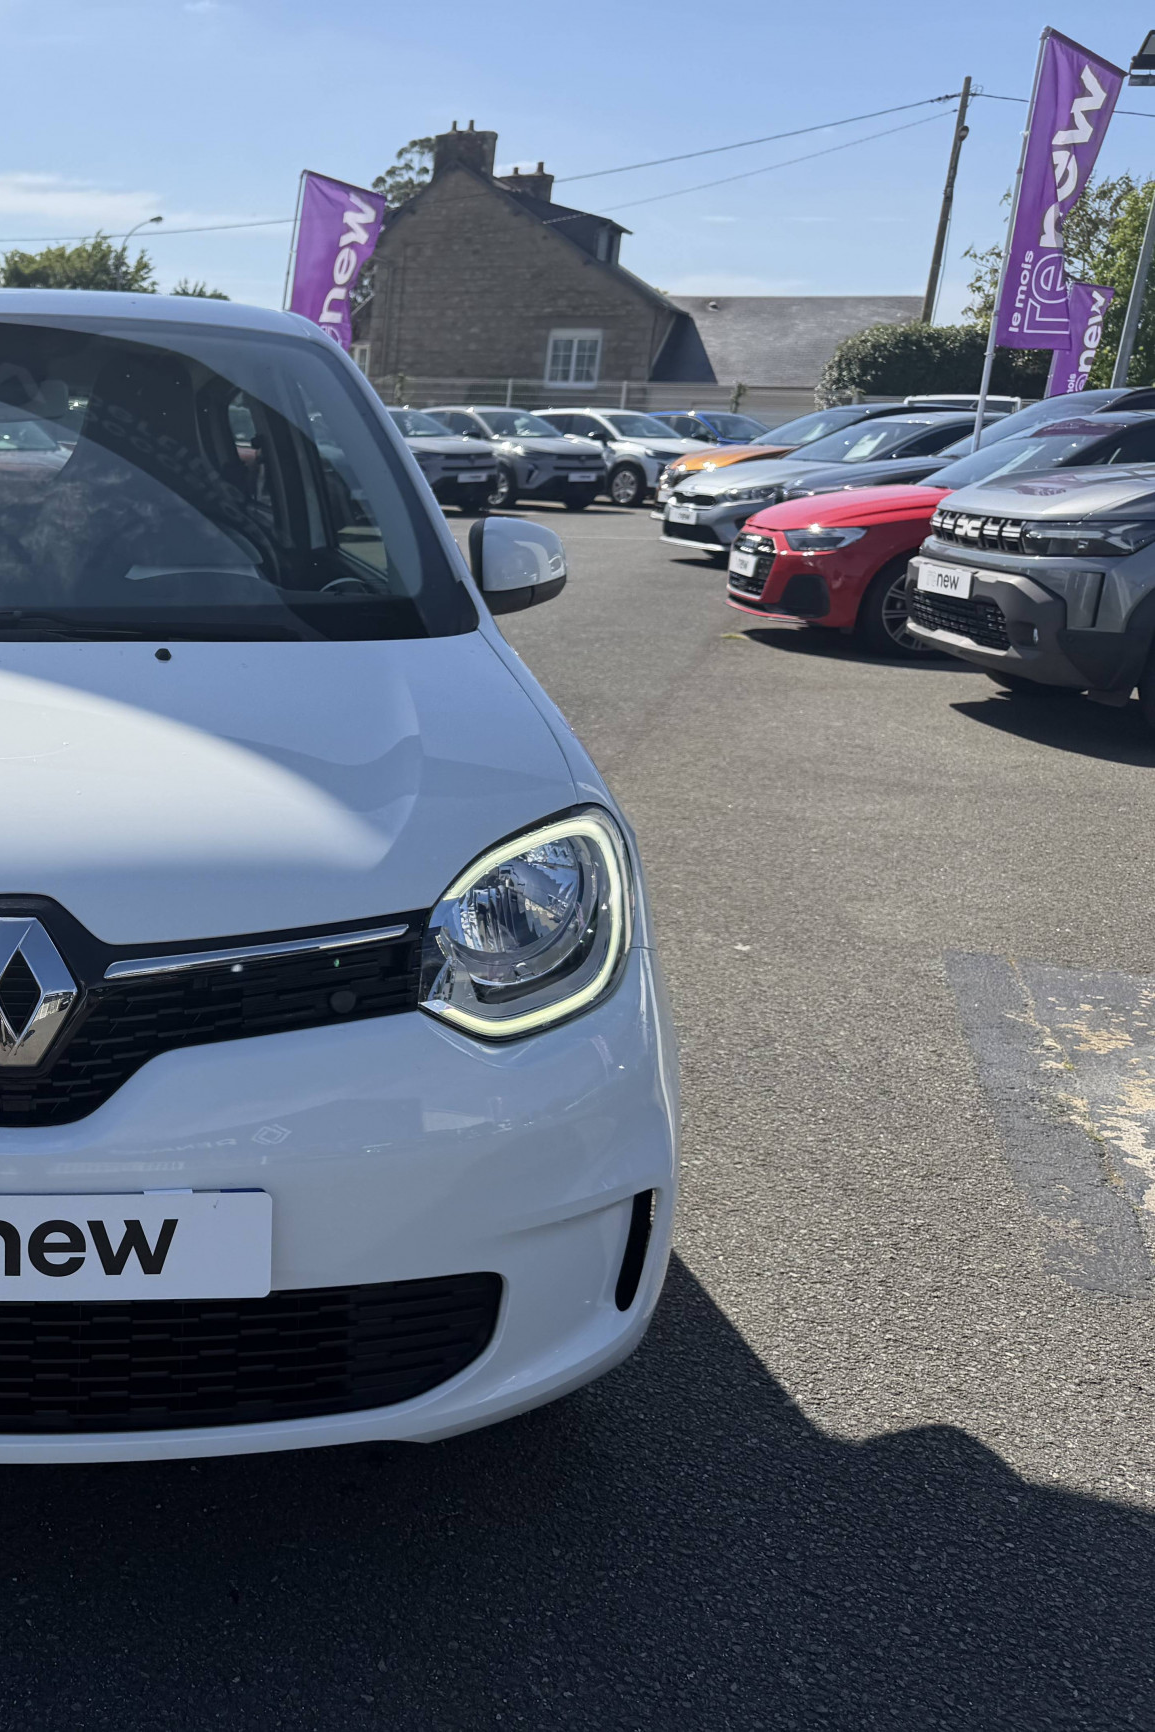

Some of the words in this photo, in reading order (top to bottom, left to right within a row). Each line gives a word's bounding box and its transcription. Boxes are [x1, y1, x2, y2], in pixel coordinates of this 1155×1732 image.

[318, 193, 377, 346] new
[1014, 250, 1034, 308] mois
[1008, 312, 1022, 333] le
[1075, 290, 1106, 392] enew
